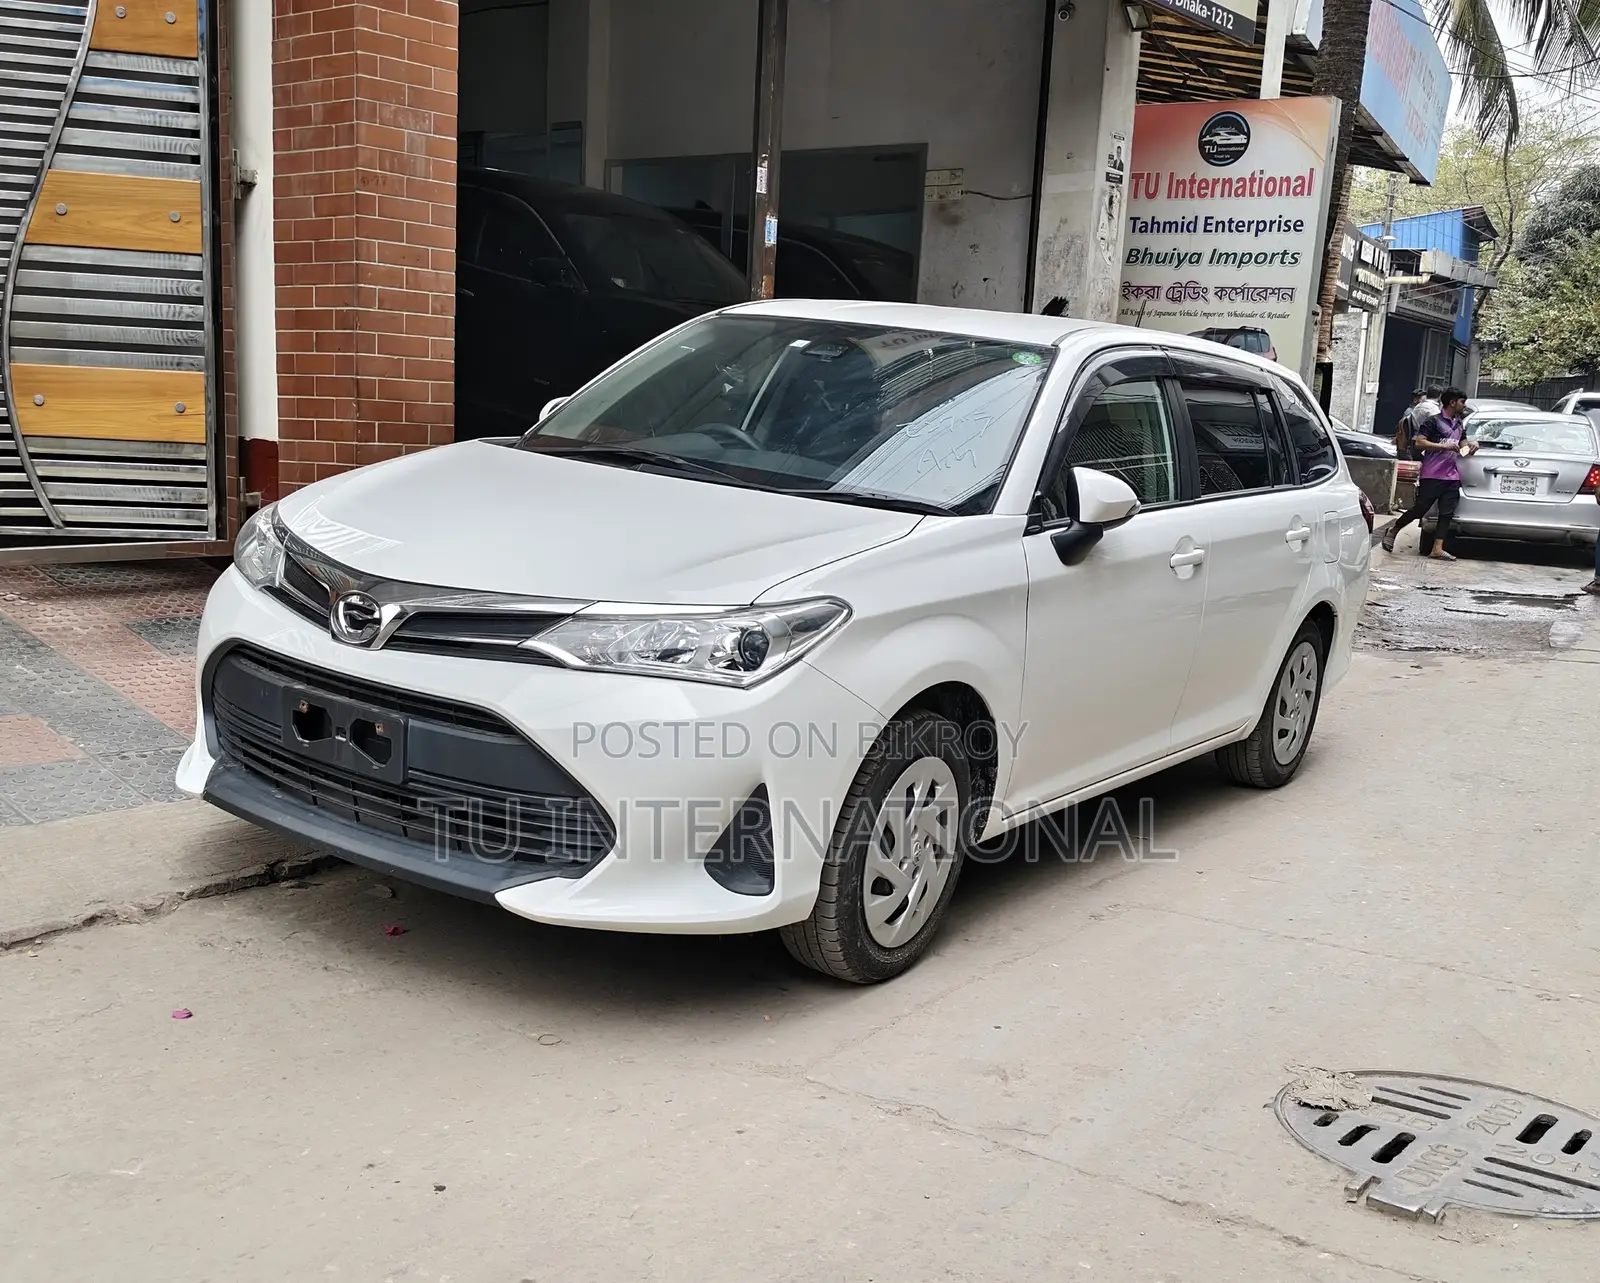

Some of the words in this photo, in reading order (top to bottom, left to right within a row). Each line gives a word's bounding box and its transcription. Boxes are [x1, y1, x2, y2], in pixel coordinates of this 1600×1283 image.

[1175, 0, 1234, 30] Dhaka-1212
[1204, 145, 1217, 153] TU
[1131, 172, 1160, 199] TU
[1167, 168, 1315, 199] International
[1129, 216, 1198, 234] Tahmid
[1203, 215, 1304, 237] Enterprise
[1125, 248, 1203, 269] Bhuiya
[1208, 248, 1301, 268] Imports
[1121, 281, 1161, 301] ইকরা
[1165, 280, 1209, 303] ট্রেডিং
[1130, 309, 1146, 317] Kins
[1146, 309, 1153, 318] of
[1152, 309, 1178, 318] Japanese
